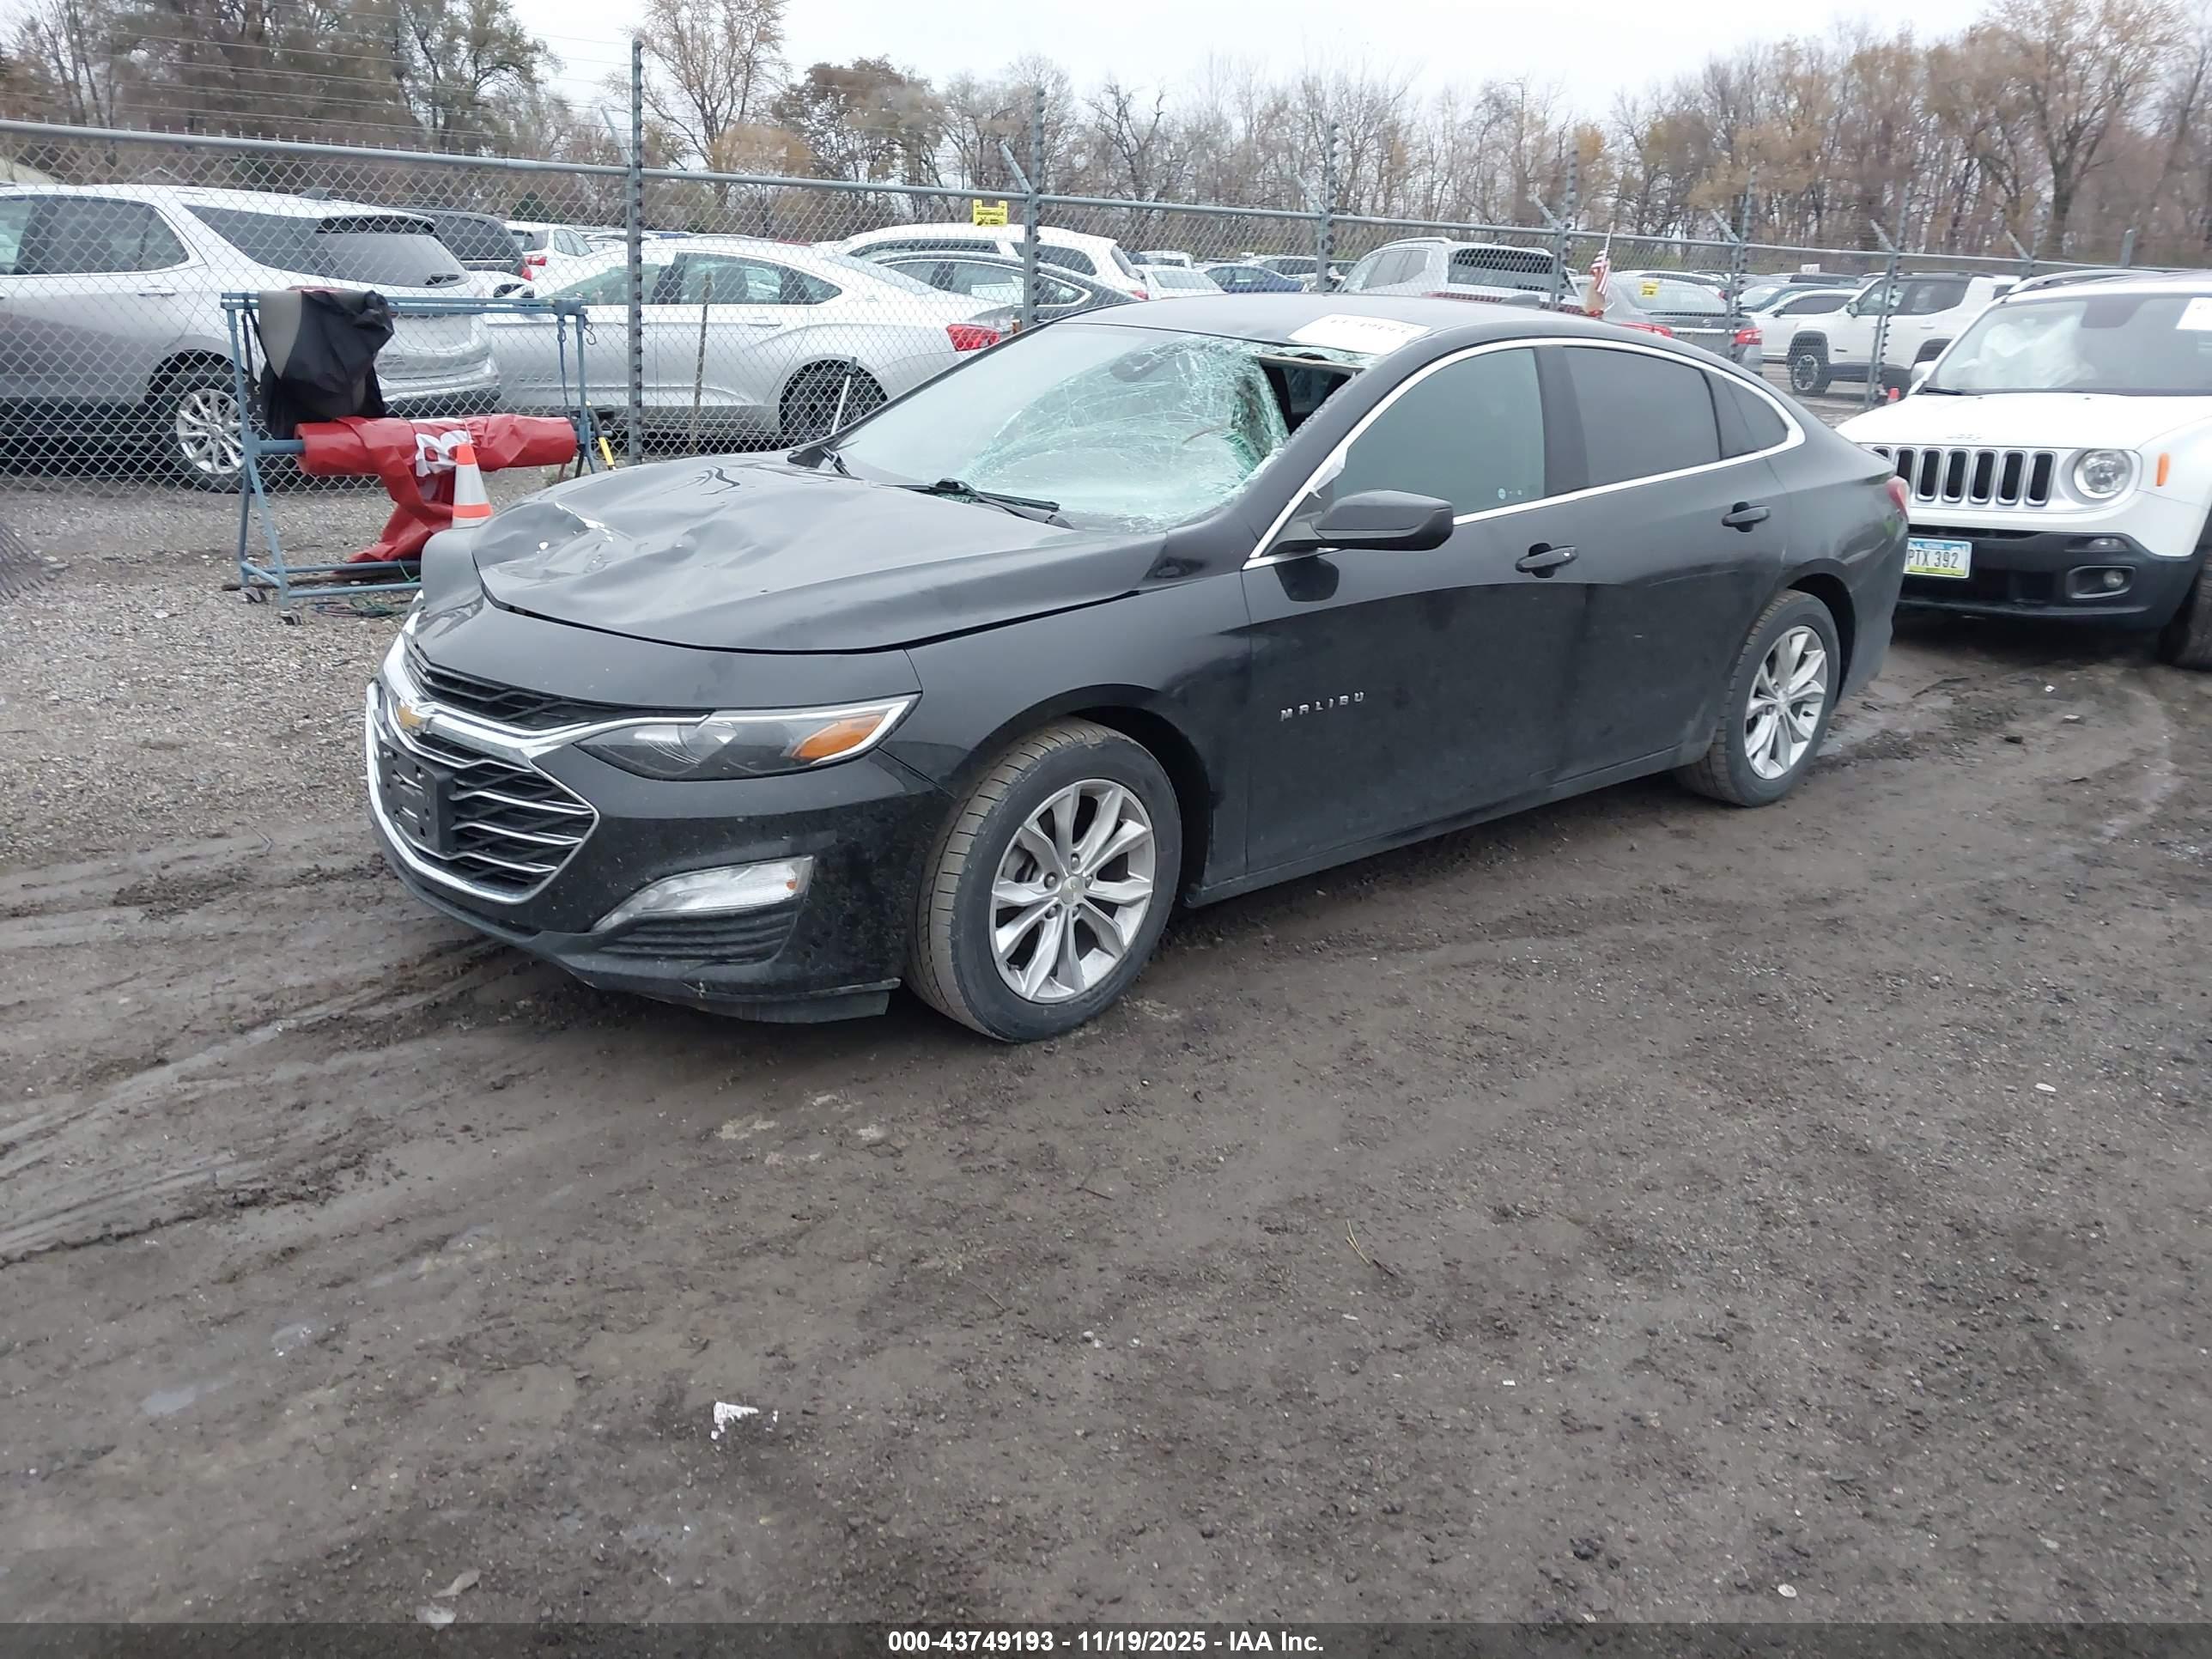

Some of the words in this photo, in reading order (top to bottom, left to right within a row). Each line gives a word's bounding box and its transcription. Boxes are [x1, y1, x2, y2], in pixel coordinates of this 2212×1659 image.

[1907, 548, 1930, 567] PTX
[1934, 550, 1959, 568] 392
[1279, 690, 1365, 722] MALIBU
